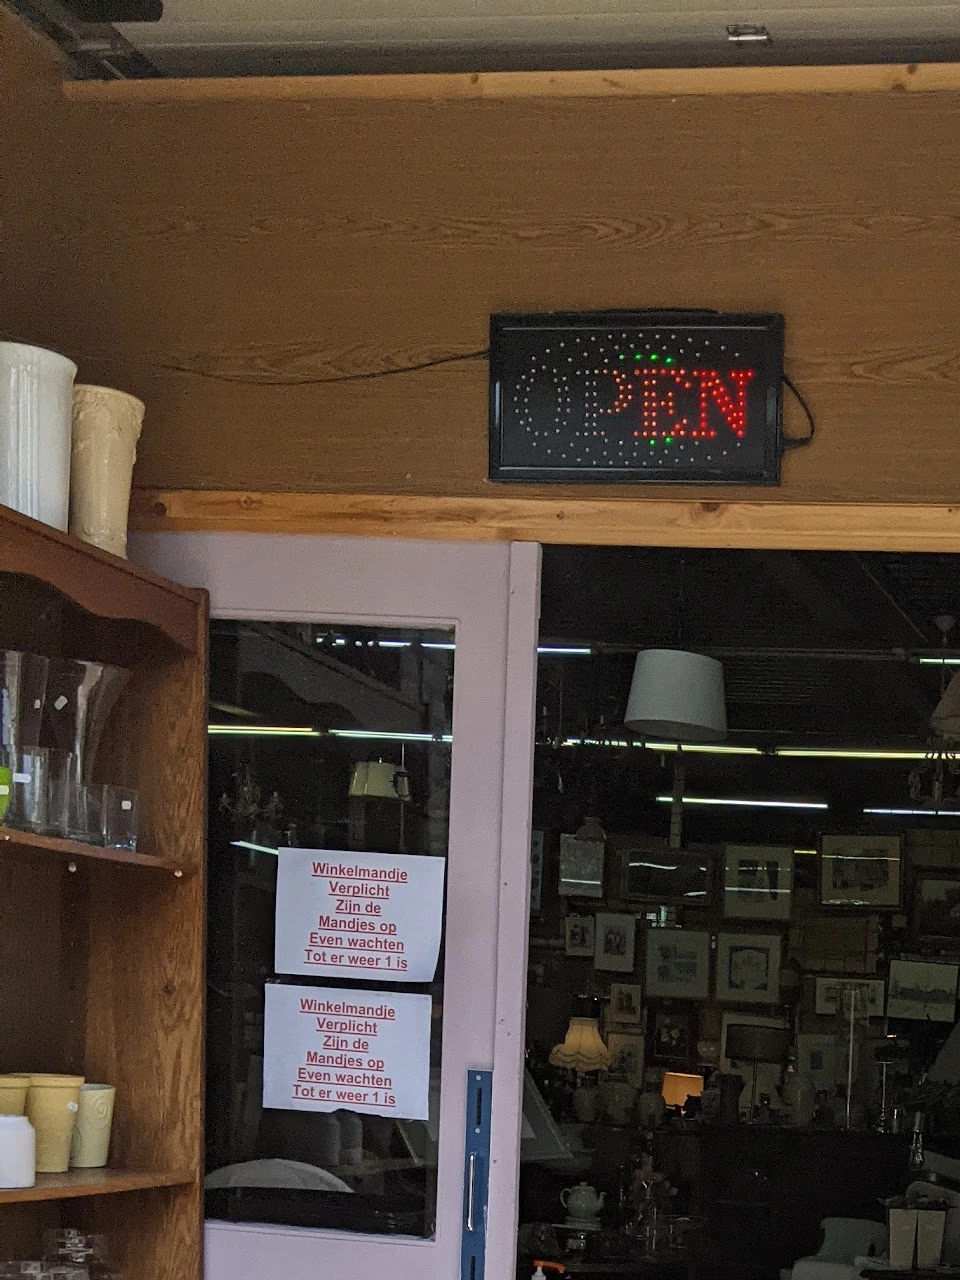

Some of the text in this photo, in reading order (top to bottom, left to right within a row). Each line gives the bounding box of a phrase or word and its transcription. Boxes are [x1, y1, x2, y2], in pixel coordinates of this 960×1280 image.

[513, 365, 755, 438] OPEN
[312, 862, 407, 882] Winkelmandje
[329, 881, 390, 897] Verplicht
[336, 900, 381, 914] Zijn de
[319, 916, 397, 934] Mandjes op
[309, 932, 404, 951] Even wachten
[305, 950, 407, 968] Tot er weer 1 is
[300, 999, 395, 1018] Winkelmandje
[317, 1018, 377, 1033] Verplicht
[323, 1036, 369, 1050] Zijn de
[306, 1051, 384, 1069] Mandjes op
[298, 1068, 392, 1087] Even wachten
[293, 1085, 395, 1105] Tot er weer 1 is
